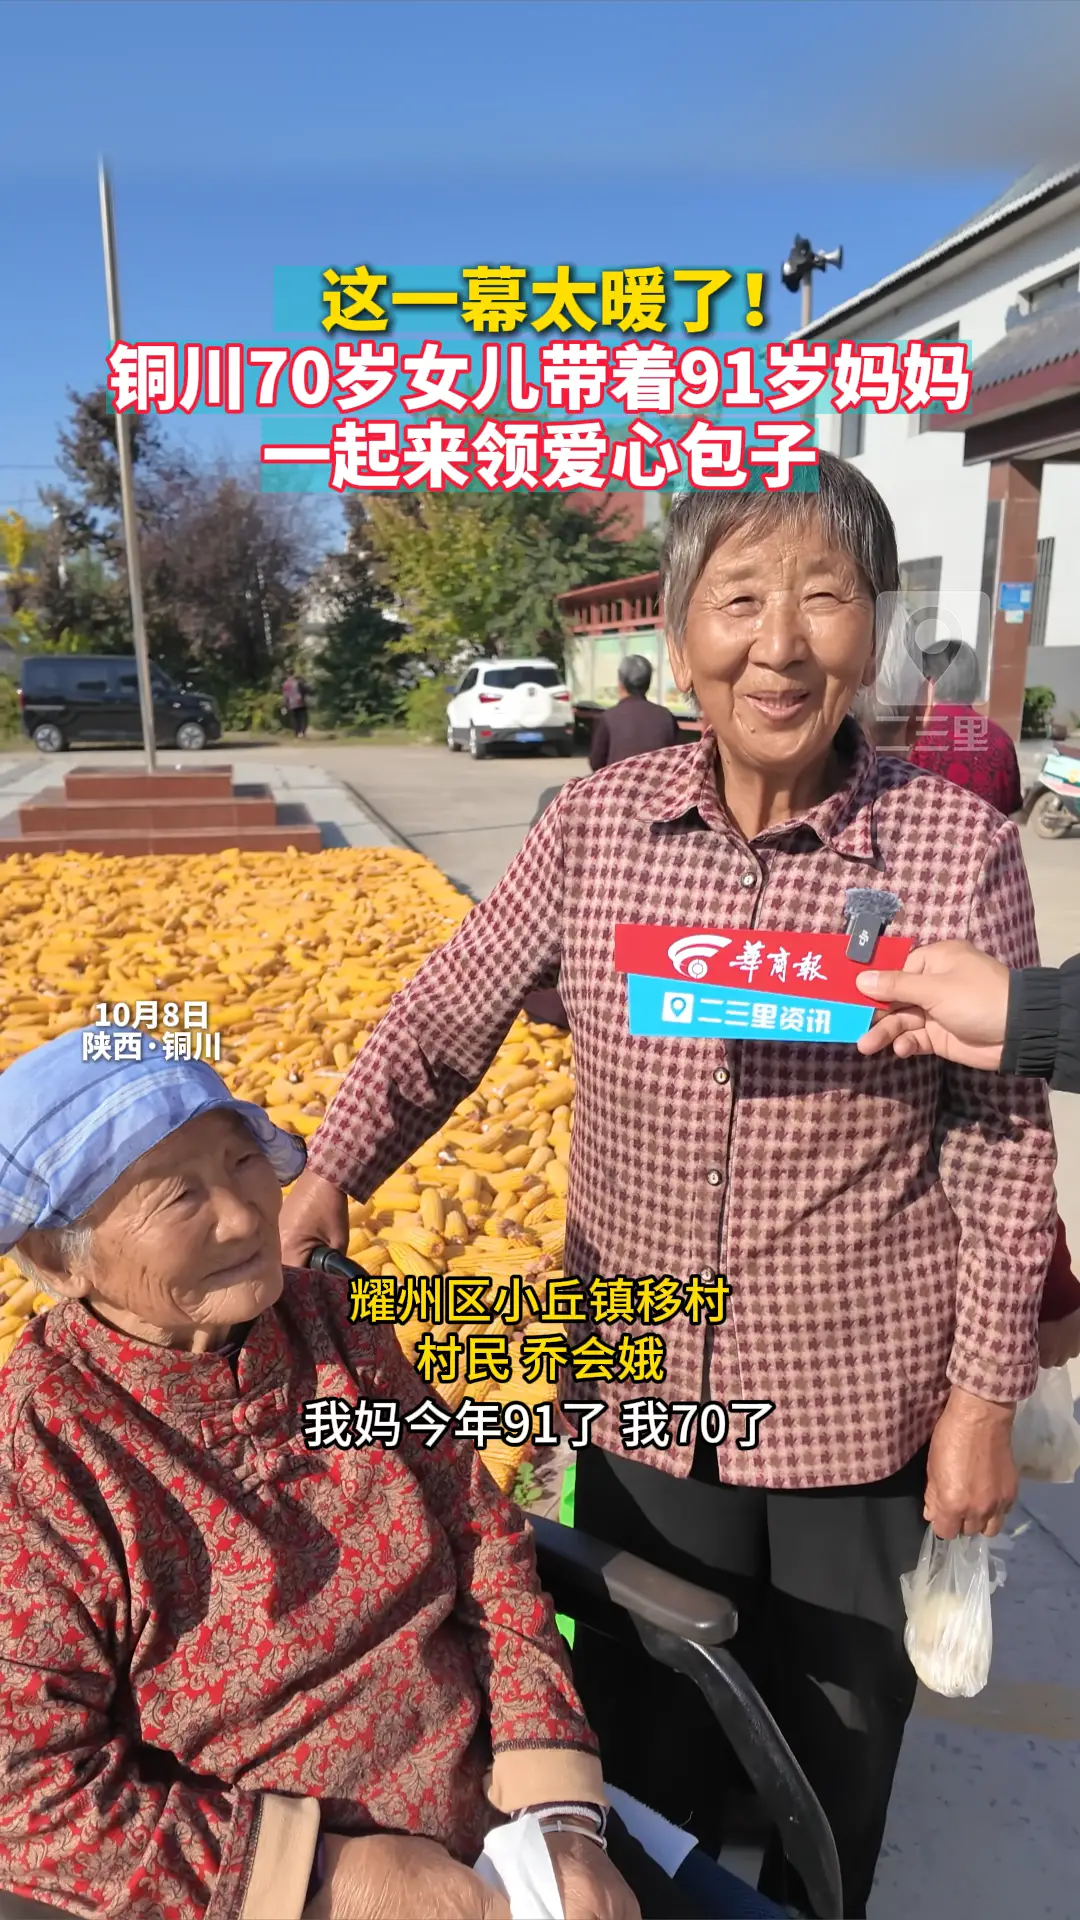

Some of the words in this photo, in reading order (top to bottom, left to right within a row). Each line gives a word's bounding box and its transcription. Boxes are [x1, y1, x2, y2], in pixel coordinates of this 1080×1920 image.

[697, 996, 832, 1035] 二三里资讯
